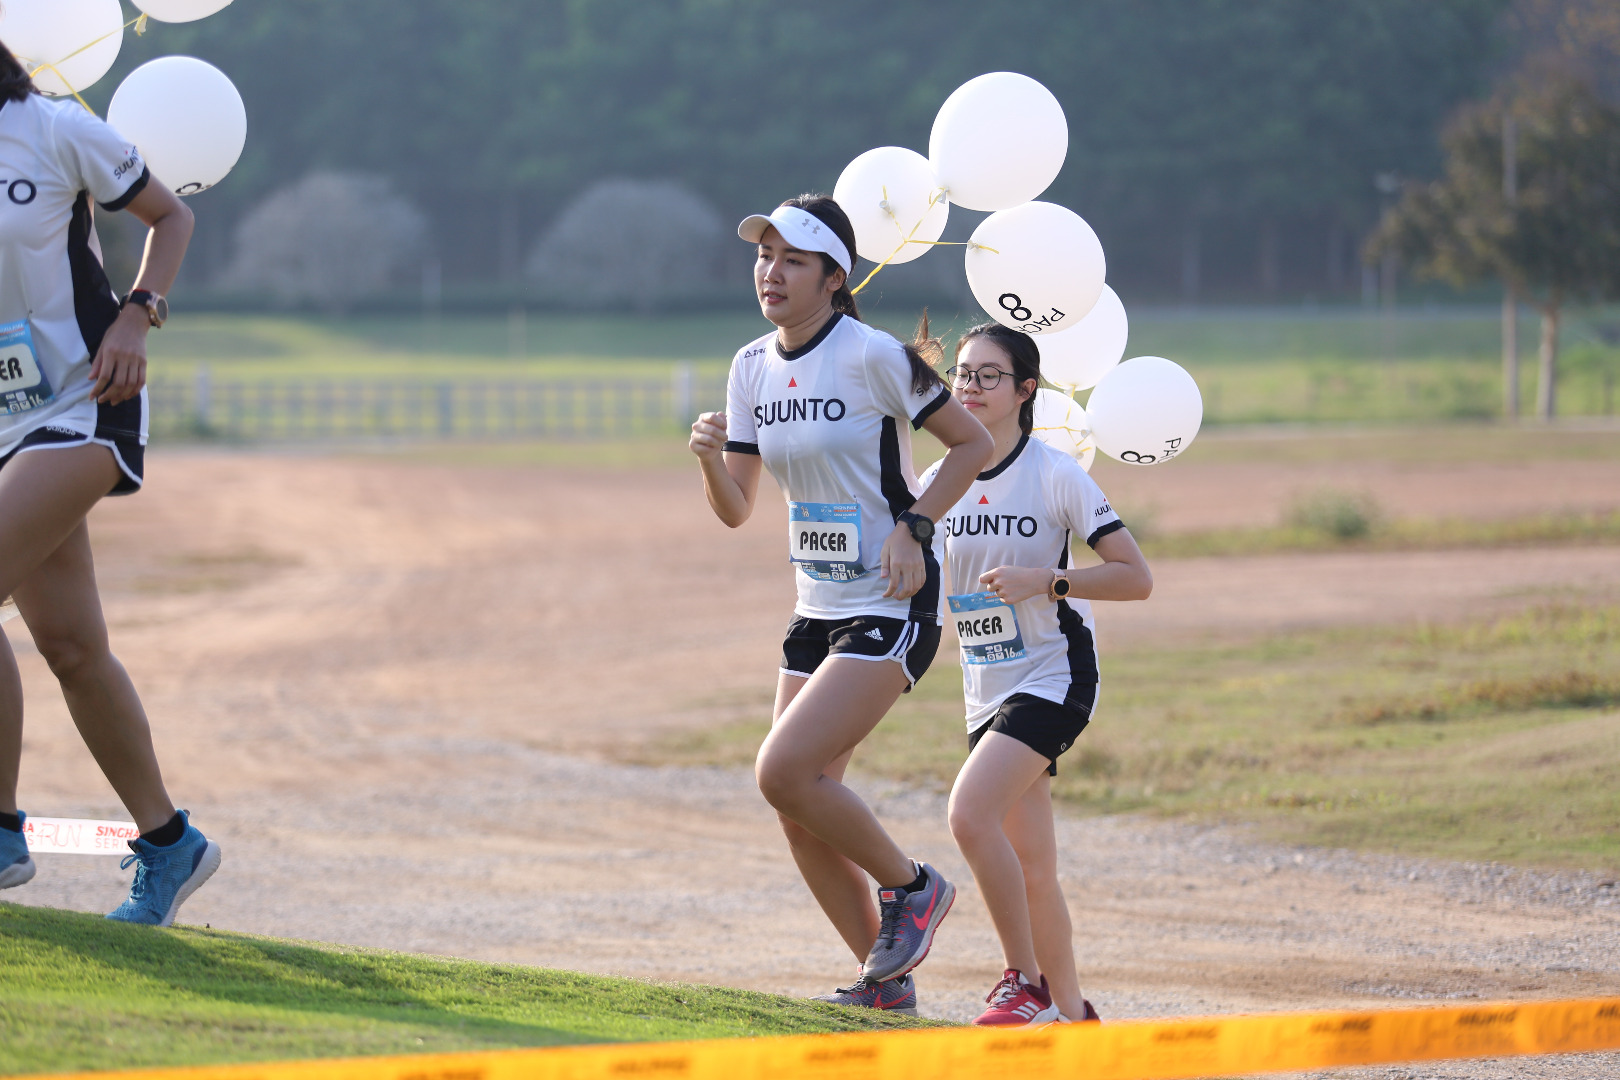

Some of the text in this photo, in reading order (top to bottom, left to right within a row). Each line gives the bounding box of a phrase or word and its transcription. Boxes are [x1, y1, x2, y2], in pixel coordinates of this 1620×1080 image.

[754, 398, 847, 429] SUUNTO
[800, 530, 847, 553] PACER
[957, 615, 1003, 638] PACER
[95, 825, 140, 839] SINGHA
